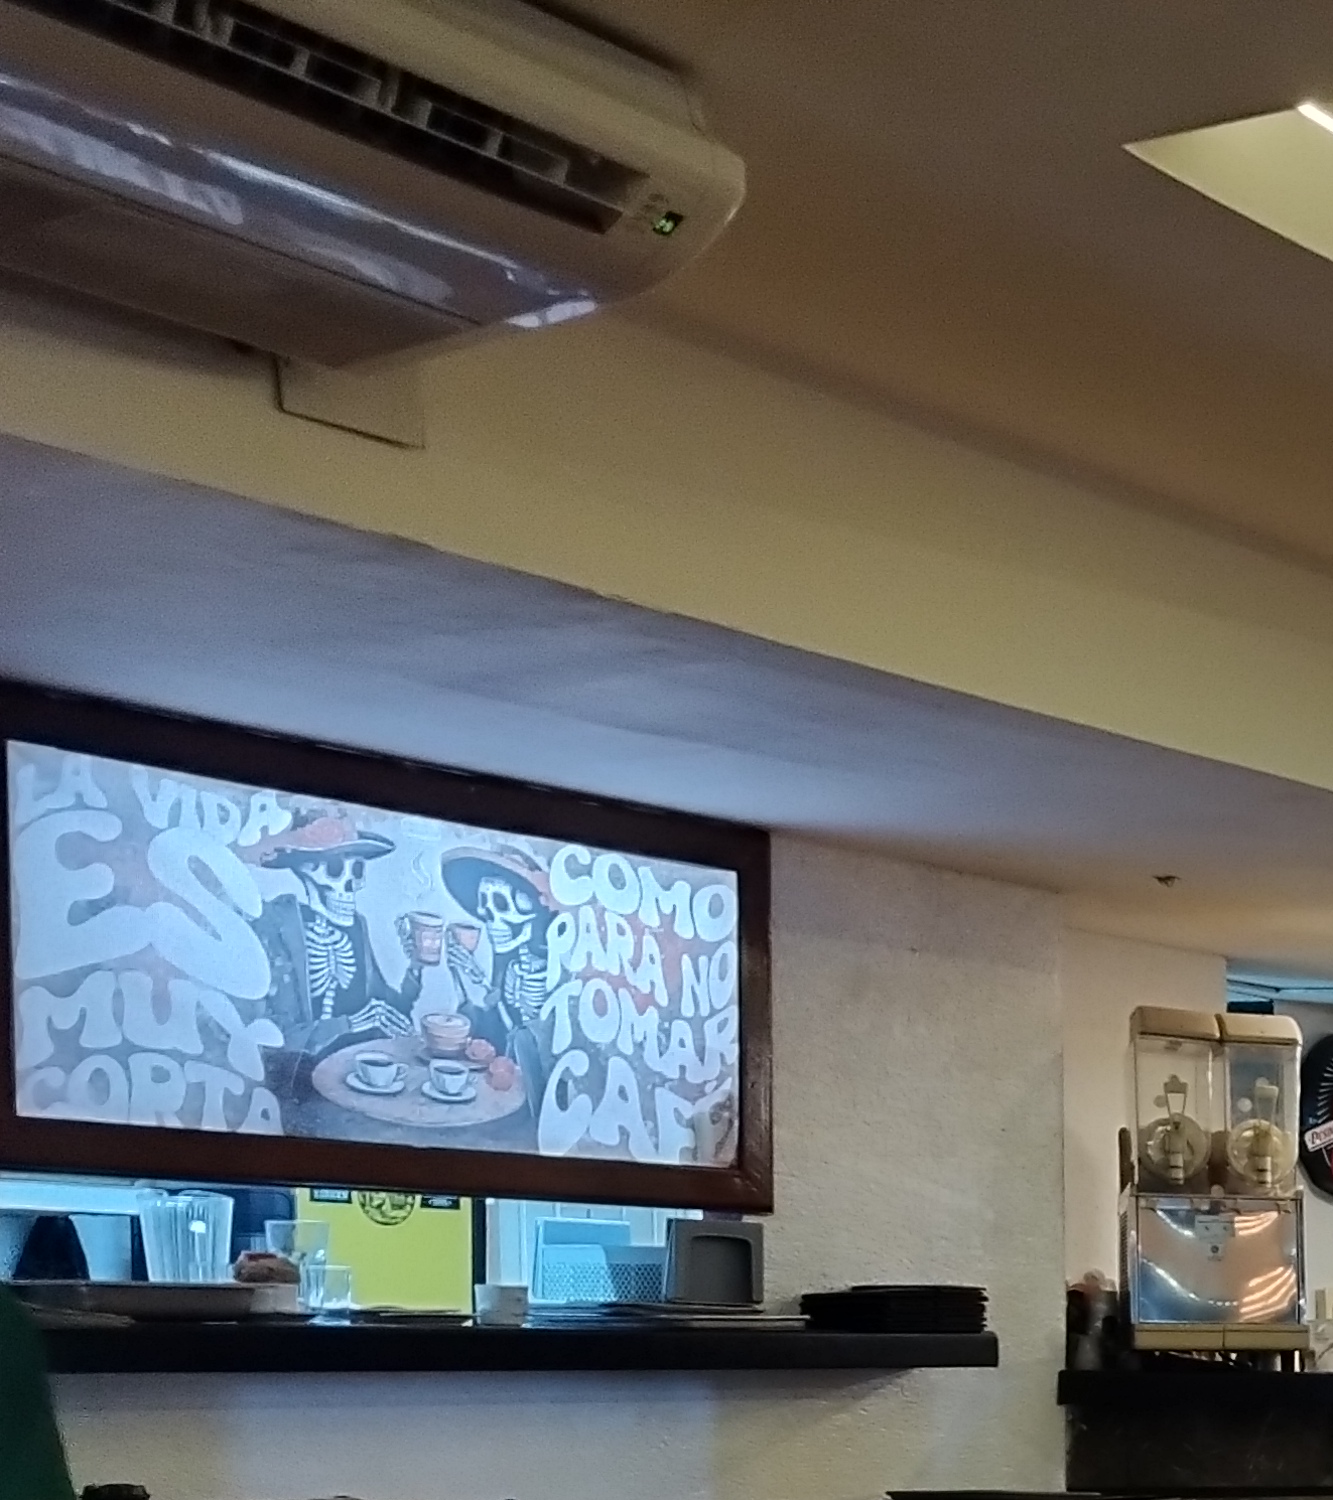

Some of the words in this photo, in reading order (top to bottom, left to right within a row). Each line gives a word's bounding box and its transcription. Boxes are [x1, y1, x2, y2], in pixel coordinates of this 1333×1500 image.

[15, 754, 108, 832] LA
[130, 765, 293, 847] VIDA
[16, 810, 271, 1000] ES
[550, 844, 737, 942] COMO
[546, 905, 669, 1008] PARA
[681, 941, 737, 1017] NO
[17, 970, 284, 1082] MUY
[540, 978, 738, 1084] TOMAR
[17, 1052, 285, 1136] CORTA
